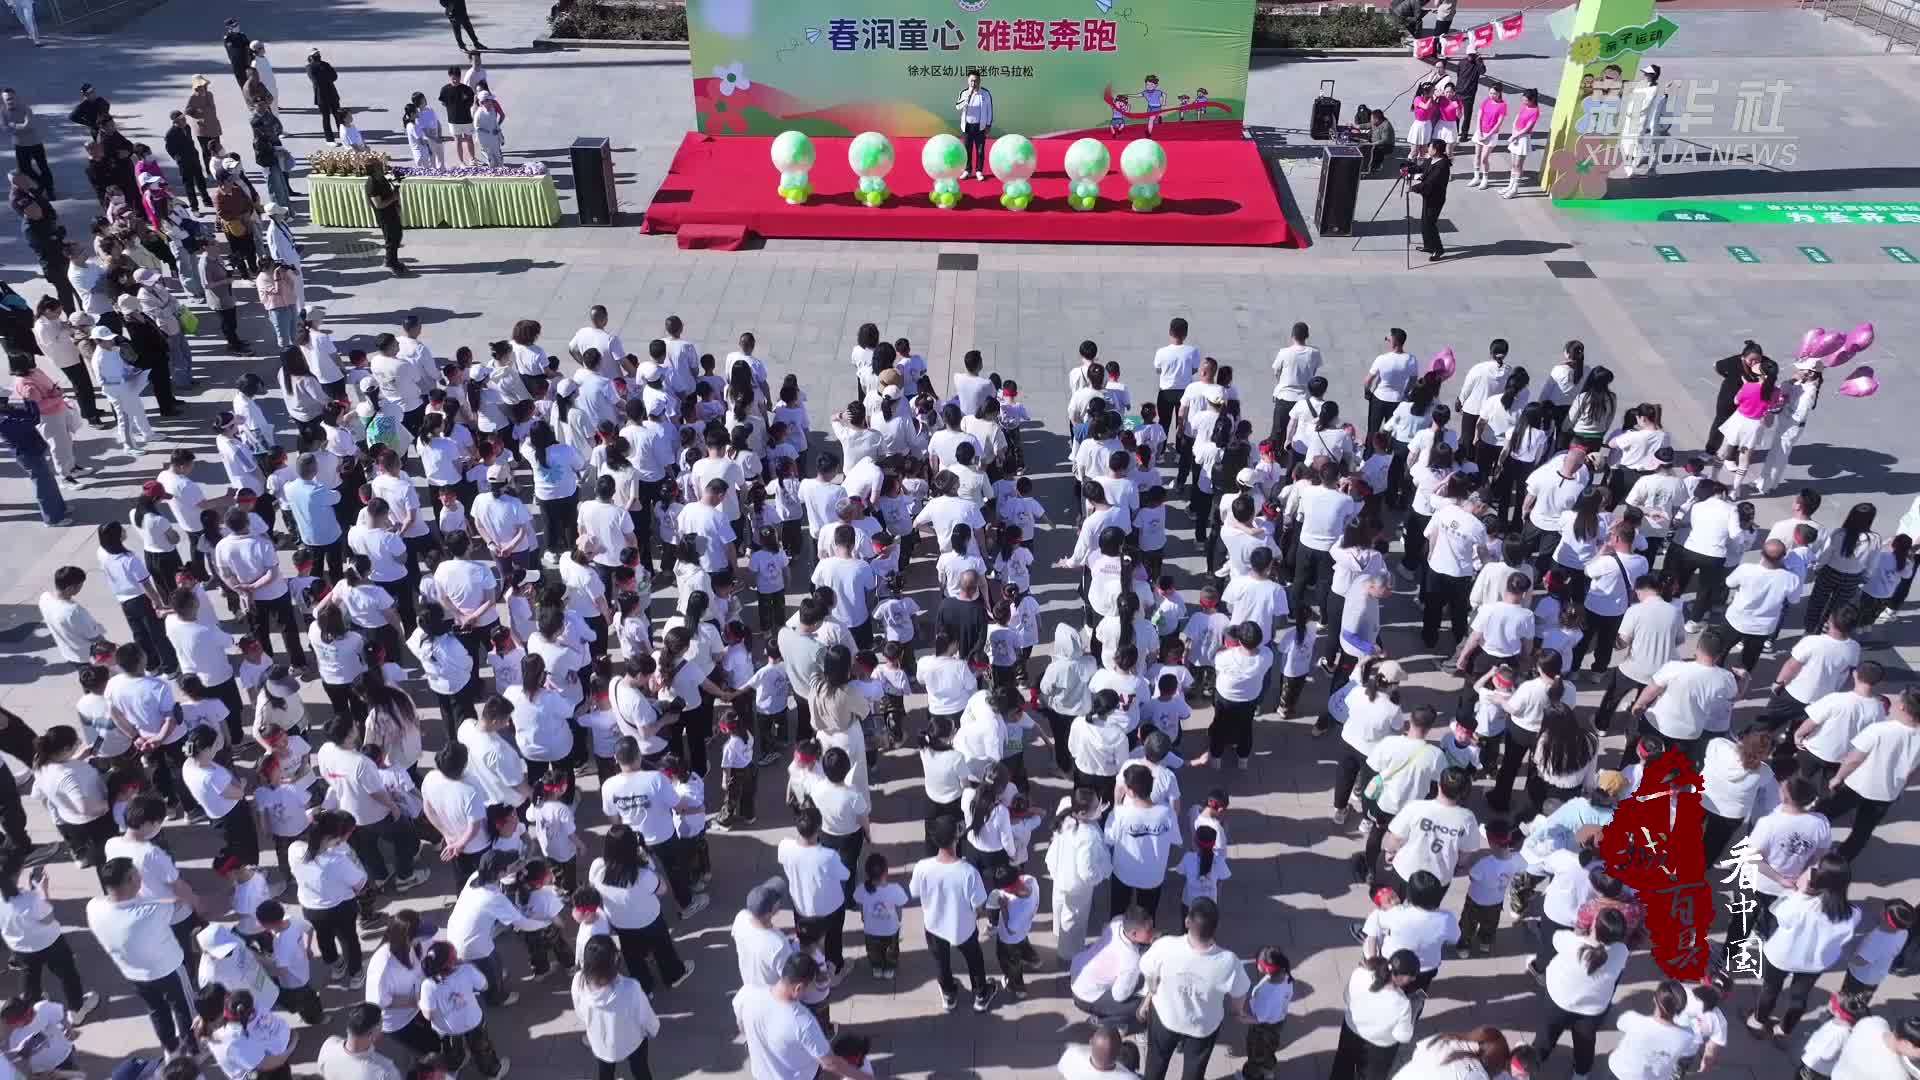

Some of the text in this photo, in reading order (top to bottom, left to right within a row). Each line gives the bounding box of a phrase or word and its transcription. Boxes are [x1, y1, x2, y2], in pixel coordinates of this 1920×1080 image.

[827, 18, 1117, 51] 春润童心 雅趣奔跑
[1431, 838, 1444, 854] 6
